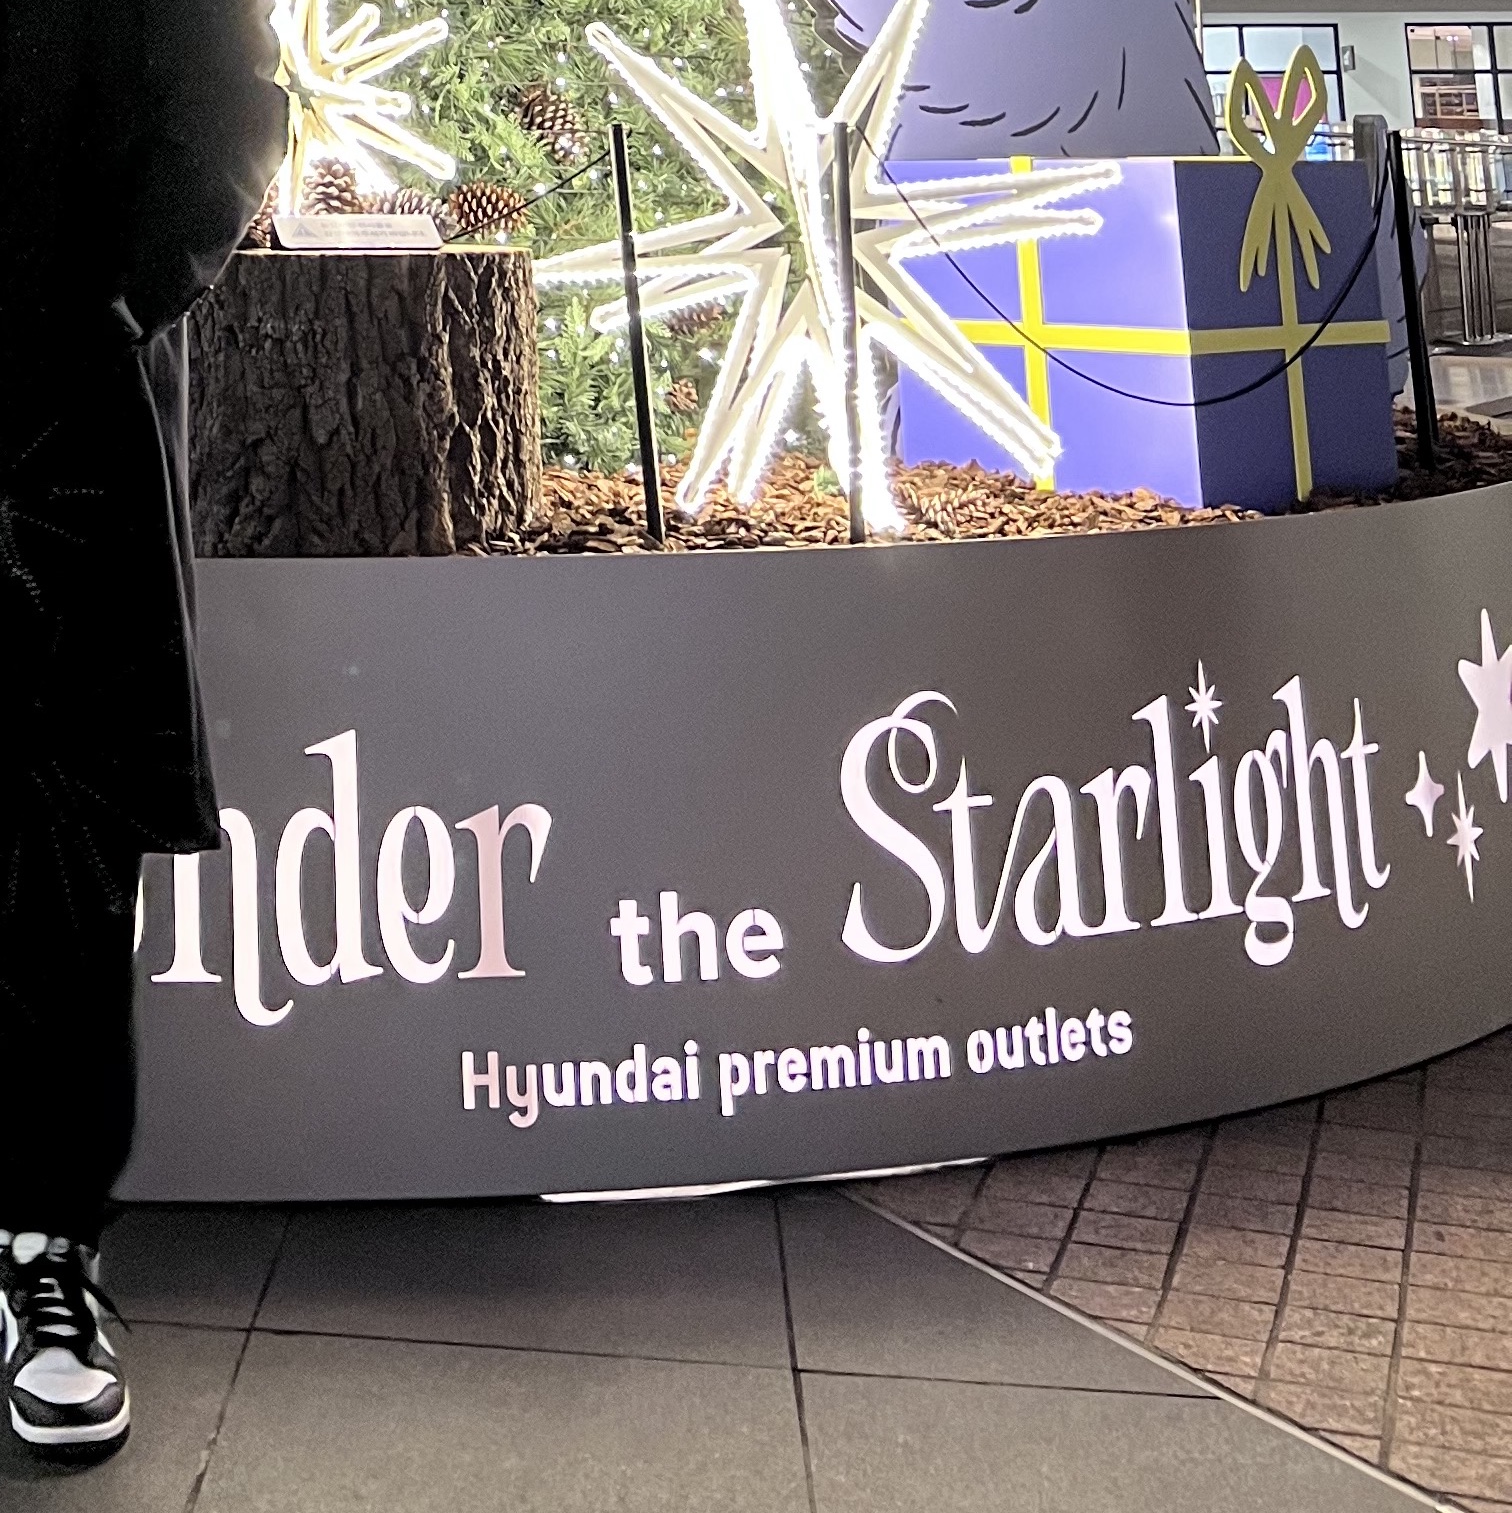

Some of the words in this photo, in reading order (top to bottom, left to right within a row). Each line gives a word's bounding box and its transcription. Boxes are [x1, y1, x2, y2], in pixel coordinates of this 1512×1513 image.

[133, 729, 554, 1027] nder
[610, 891, 785, 987] the
[840, 658, 1391, 967] Starlight
[461, 1040, 701, 1129] Hyundai
[719, 1027, 952, 1118] premium
[967, 1007, 1134, 1075] outlets
